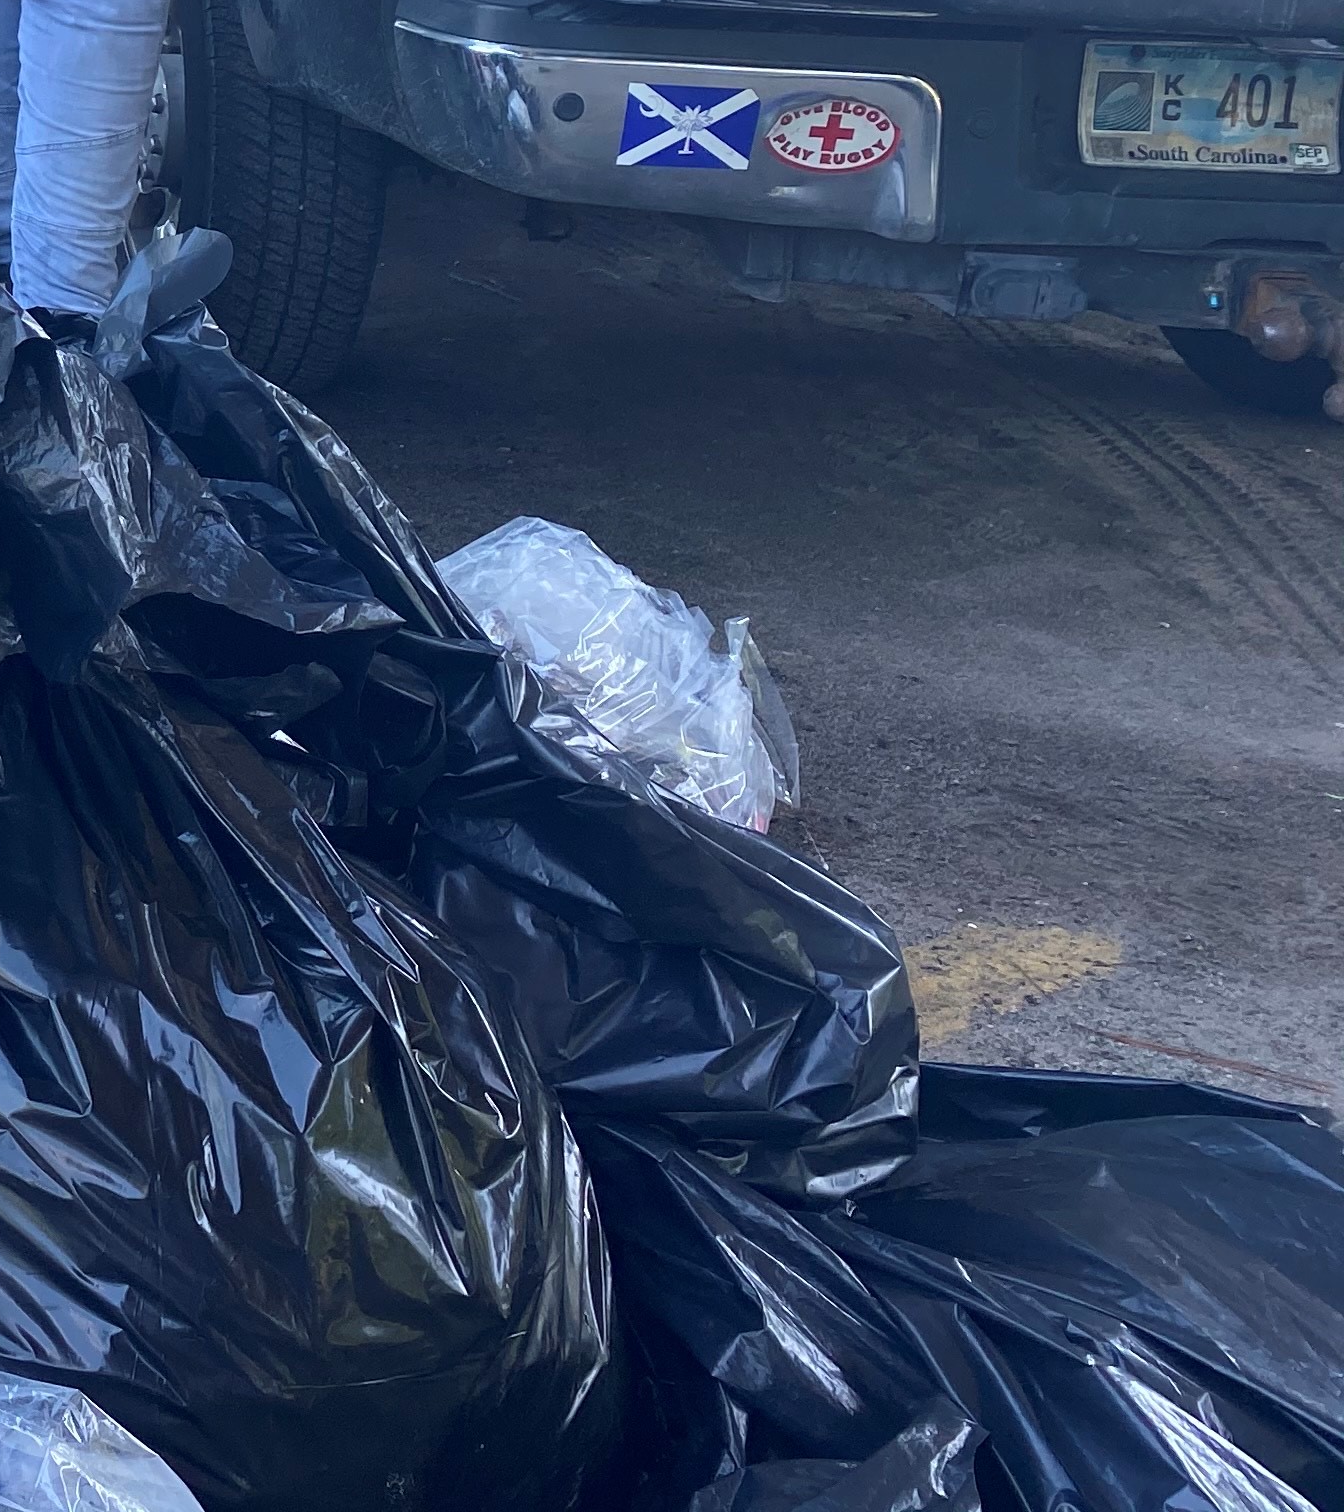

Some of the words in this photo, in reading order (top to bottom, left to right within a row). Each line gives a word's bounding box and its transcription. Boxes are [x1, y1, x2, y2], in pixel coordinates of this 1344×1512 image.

[830, 101, 891, 132] BLOOD
[1215, 72, 1300, 130] 401
[772, 133, 815, 161] PLAY
[819, 138, 887, 165] RUGBY
[1137, 144, 1189, 163] South
[1195, 146, 1279, 165] Carolina
[1295, 147, 1322, 158] SEP
